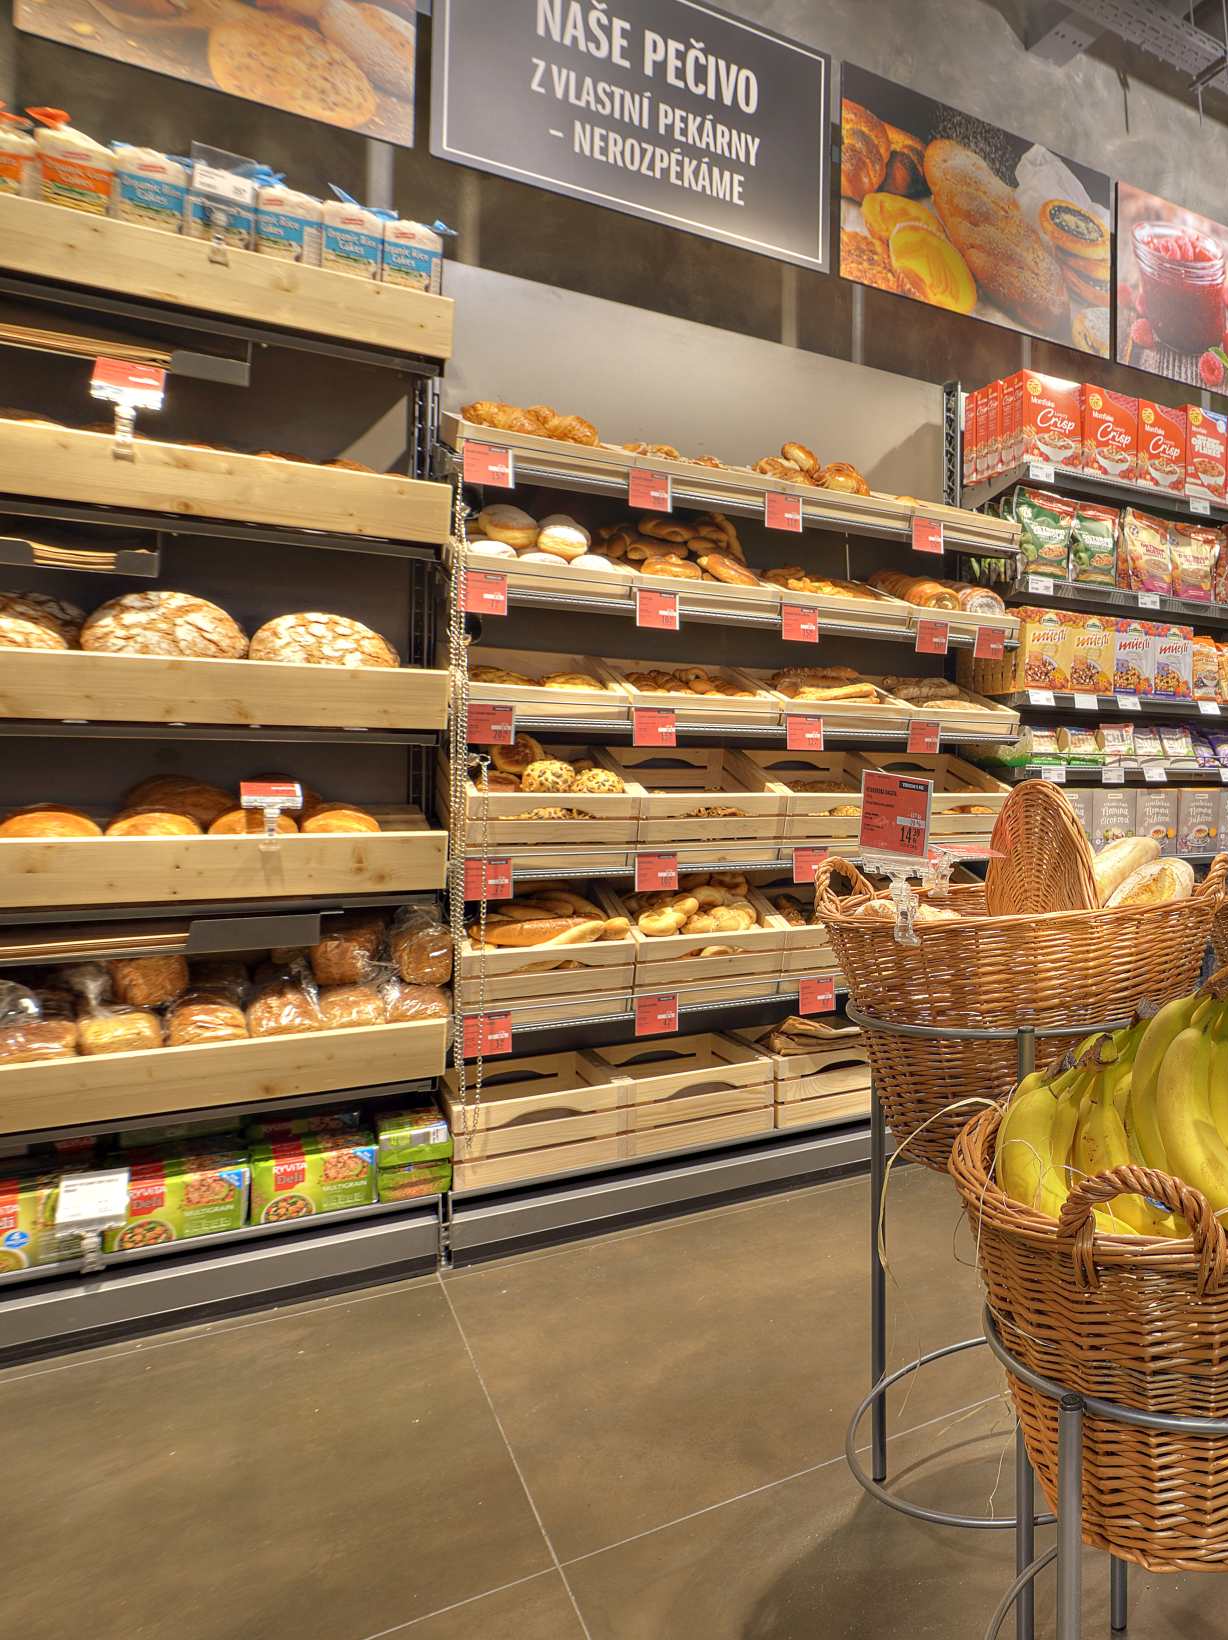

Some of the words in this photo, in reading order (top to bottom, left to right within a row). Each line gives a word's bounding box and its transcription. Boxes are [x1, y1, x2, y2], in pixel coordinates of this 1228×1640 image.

[536, 0, 631, 69] NAŠE
[643, 29, 758, 114] PEČIVO
[531, 57, 546, 94] Z
[551, 63, 652, 130] VLASTNÍ
[658, 102, 760, 167] PEKÁRNY
[574, 120, 745, 206] NEROZPÉKÁME
[1037, 408, 1075, 434] Crisp
[1097, 422, 1132, 448] Crisp
[1149, 435, 1180, 459] Crisp
[272, 1162, 308, 1174] RYVITA
[276, 1173, 303, 1185] Deli
